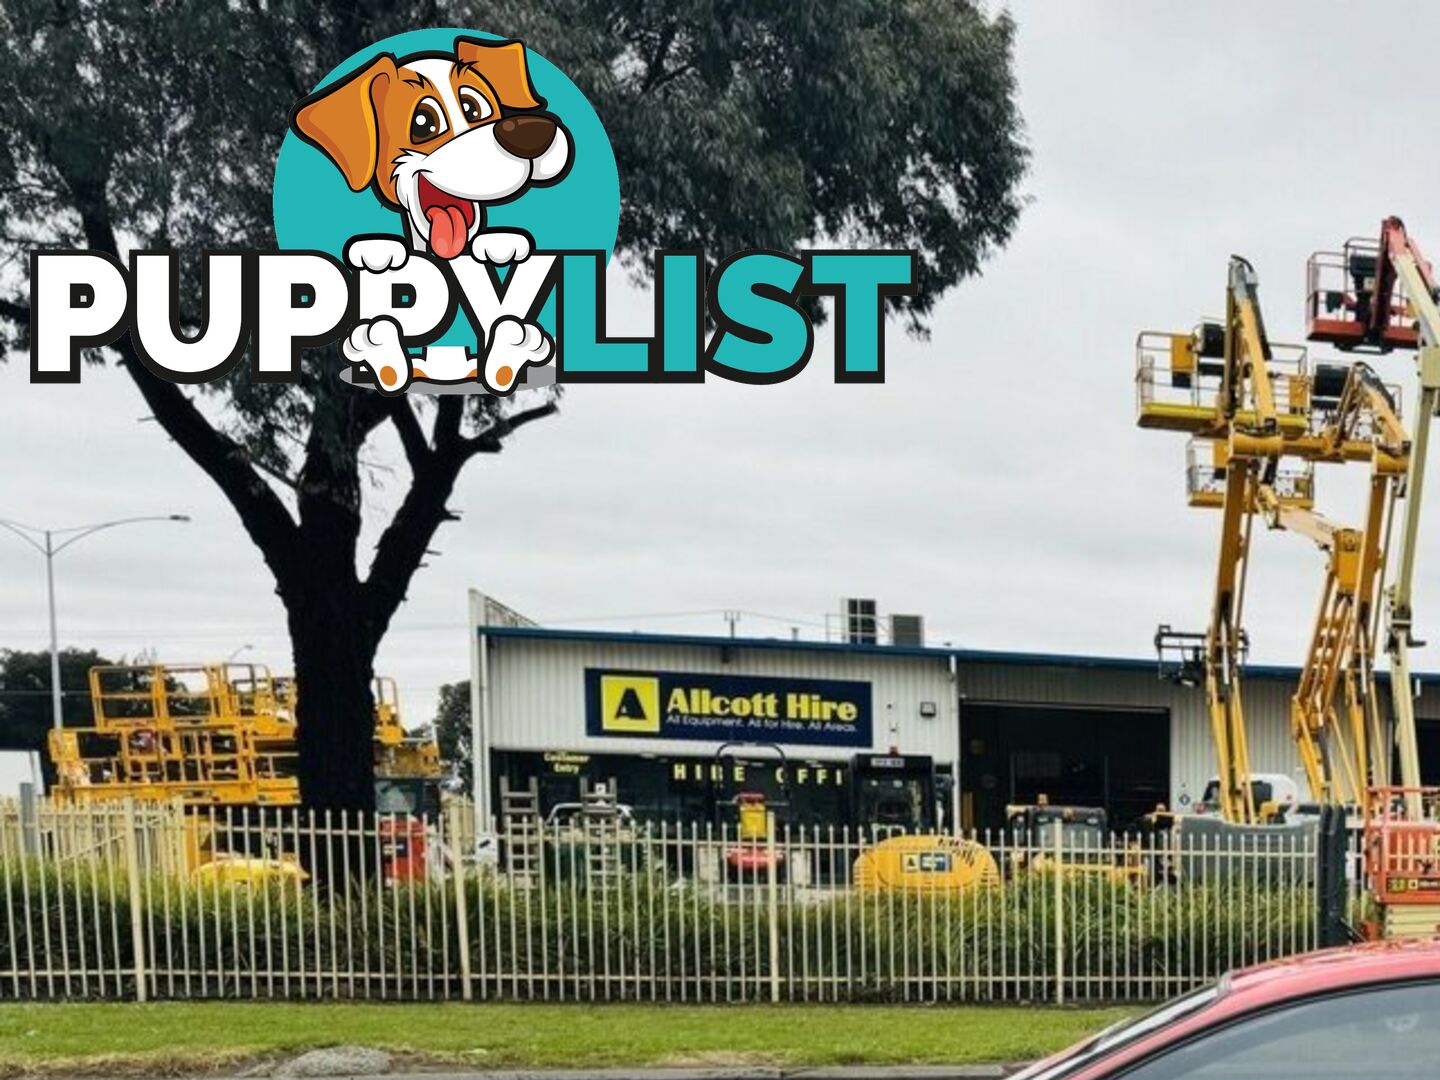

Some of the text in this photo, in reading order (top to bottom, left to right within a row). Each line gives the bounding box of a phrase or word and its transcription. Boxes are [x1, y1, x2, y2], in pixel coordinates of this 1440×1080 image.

[614, 687, 648, 721] A
[667, 687, 858, 722] Allcott Hire
[666, 714, 681, 724] All
[747, 717, 762, 727] All
[807, 721, 822, 731] All
